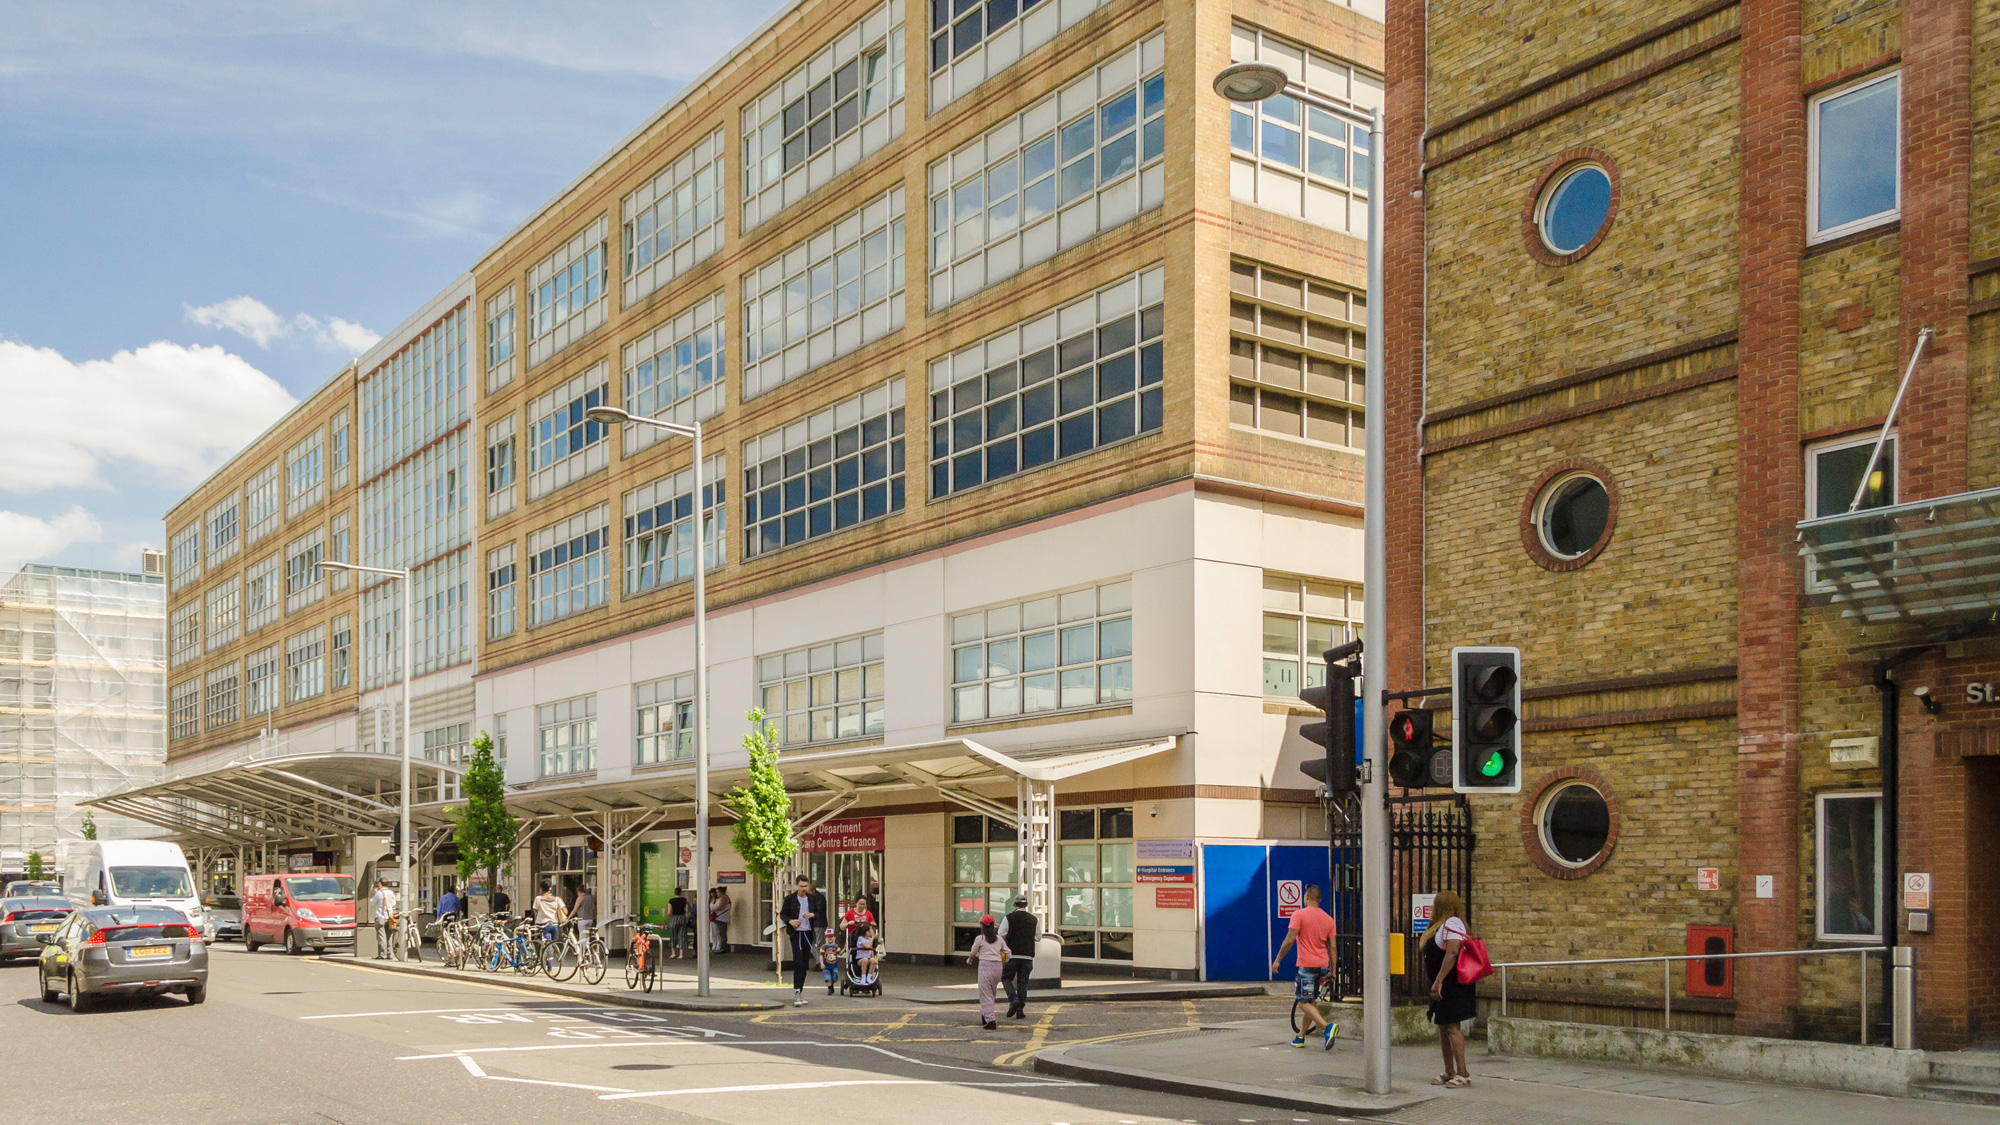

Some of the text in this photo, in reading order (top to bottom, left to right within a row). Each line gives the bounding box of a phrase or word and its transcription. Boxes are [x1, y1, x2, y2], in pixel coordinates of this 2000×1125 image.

[1966, 682, 2000, 703] St.
[818, 822, 861, 836] Department
[816, 837, 840, 848] Centre
[842, 836, 877, 848] Entrance
